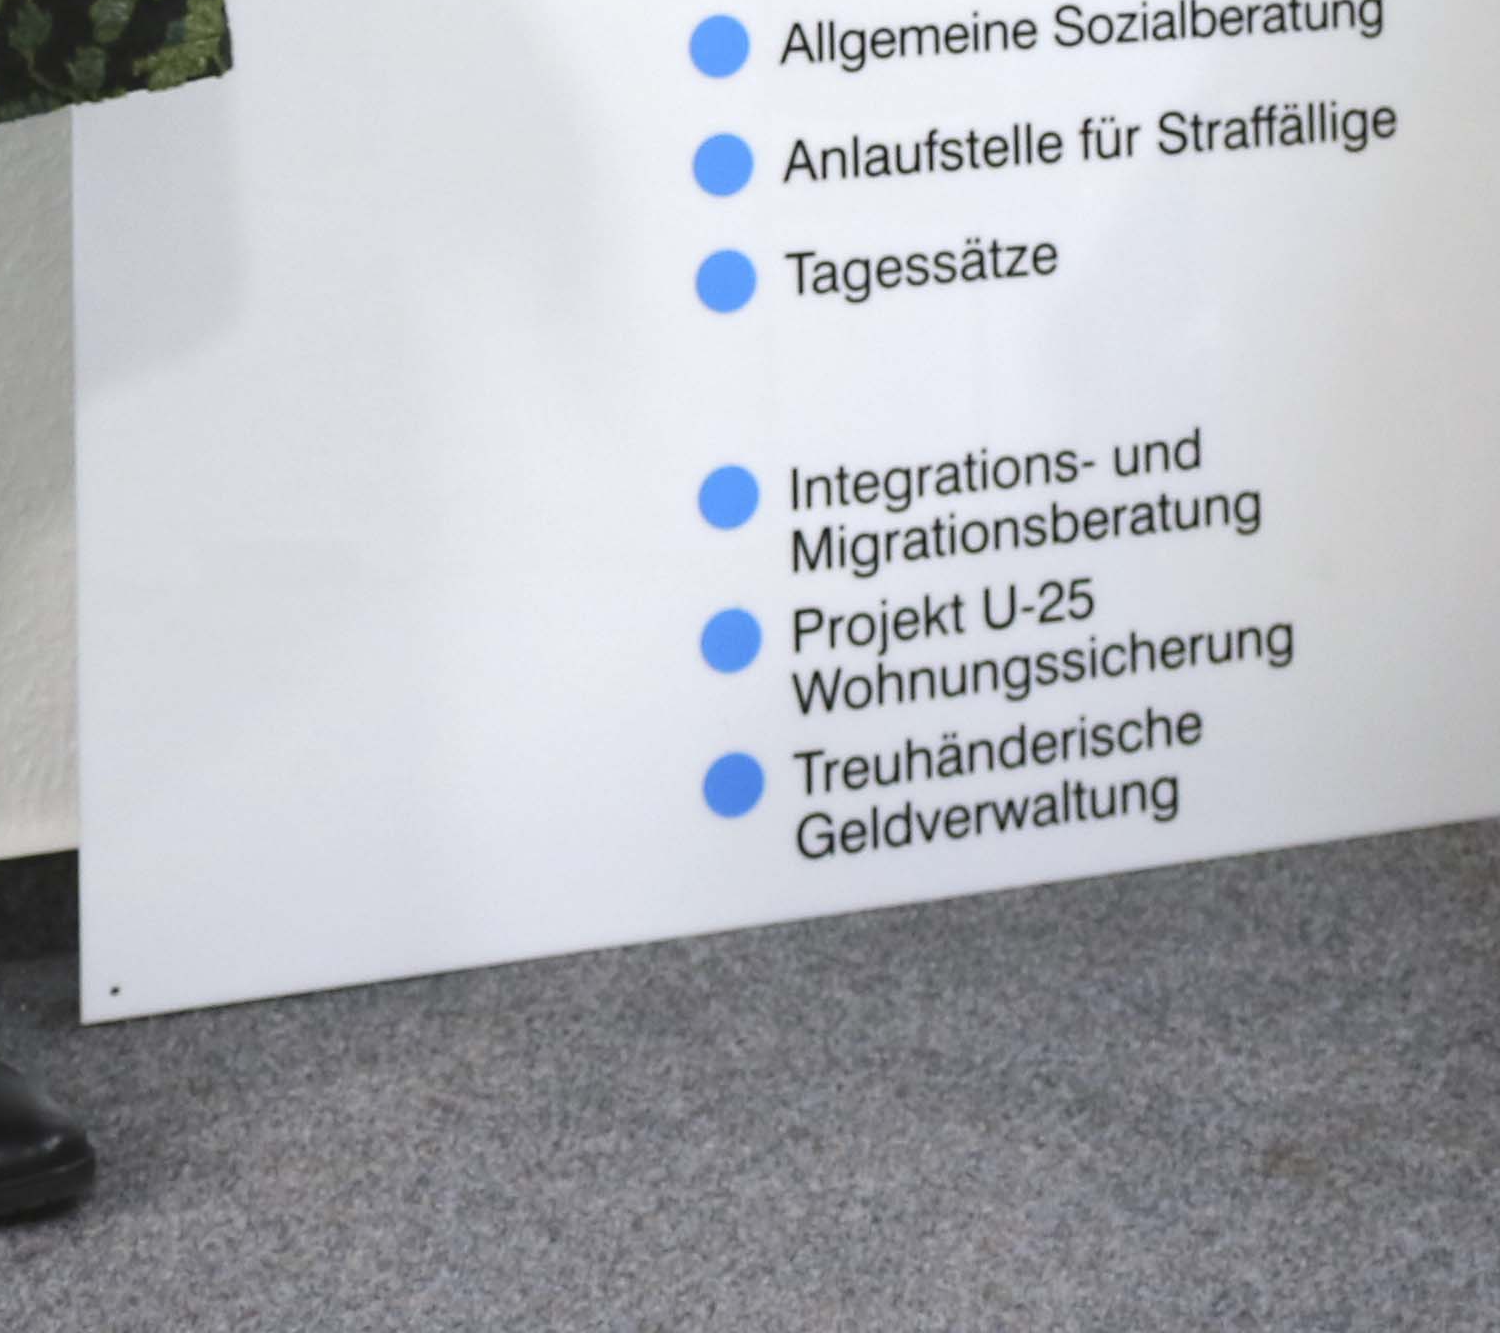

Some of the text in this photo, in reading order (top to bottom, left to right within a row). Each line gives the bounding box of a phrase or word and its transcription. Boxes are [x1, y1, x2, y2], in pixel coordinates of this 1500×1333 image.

[779, 20, 1038, 74] Allgemeine
[782, 100, 1398, 184] Anlaufstelle für Straffällige
[784, 237, 1059, 305] Tagessätze
[790, 427, 1202, 512] Integrations- und
[792, 489, 1262, 579] Migrationsberatung
[793, 579, 1094, 656] Projekt U-25
[793, 622, 1295, 716] Wohnungssicherung
[794, 709, 1203, 796] Treuhänderische
[796, 775, 1180, 859] Geldverwaltung
